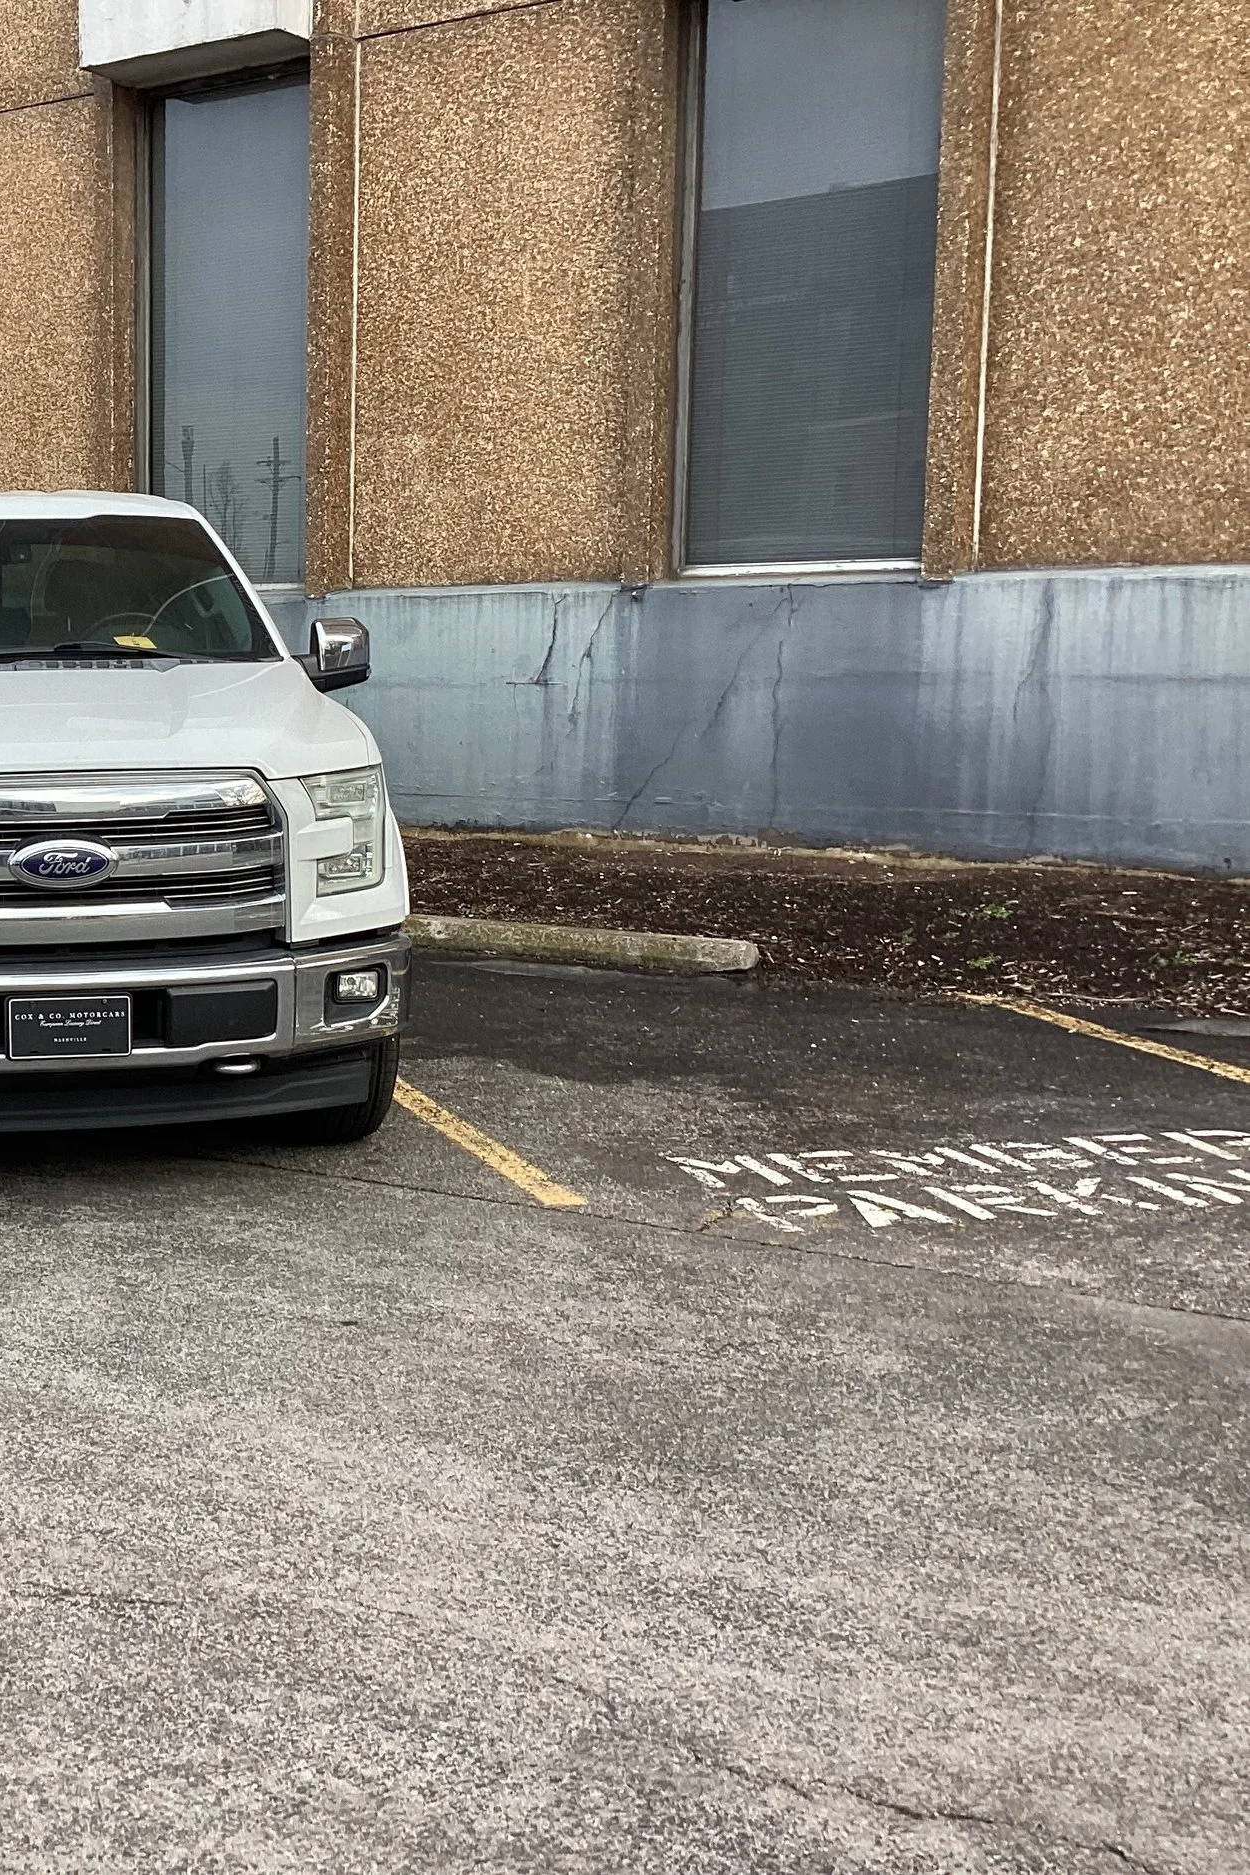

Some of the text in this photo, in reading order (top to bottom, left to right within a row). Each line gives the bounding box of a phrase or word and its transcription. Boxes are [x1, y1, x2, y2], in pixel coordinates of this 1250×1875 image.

[38, 852, 91, 875] Ford
[14, 1013, 33, 1021] COX
[69, 1011, 125, 1019] MOTORCARS
